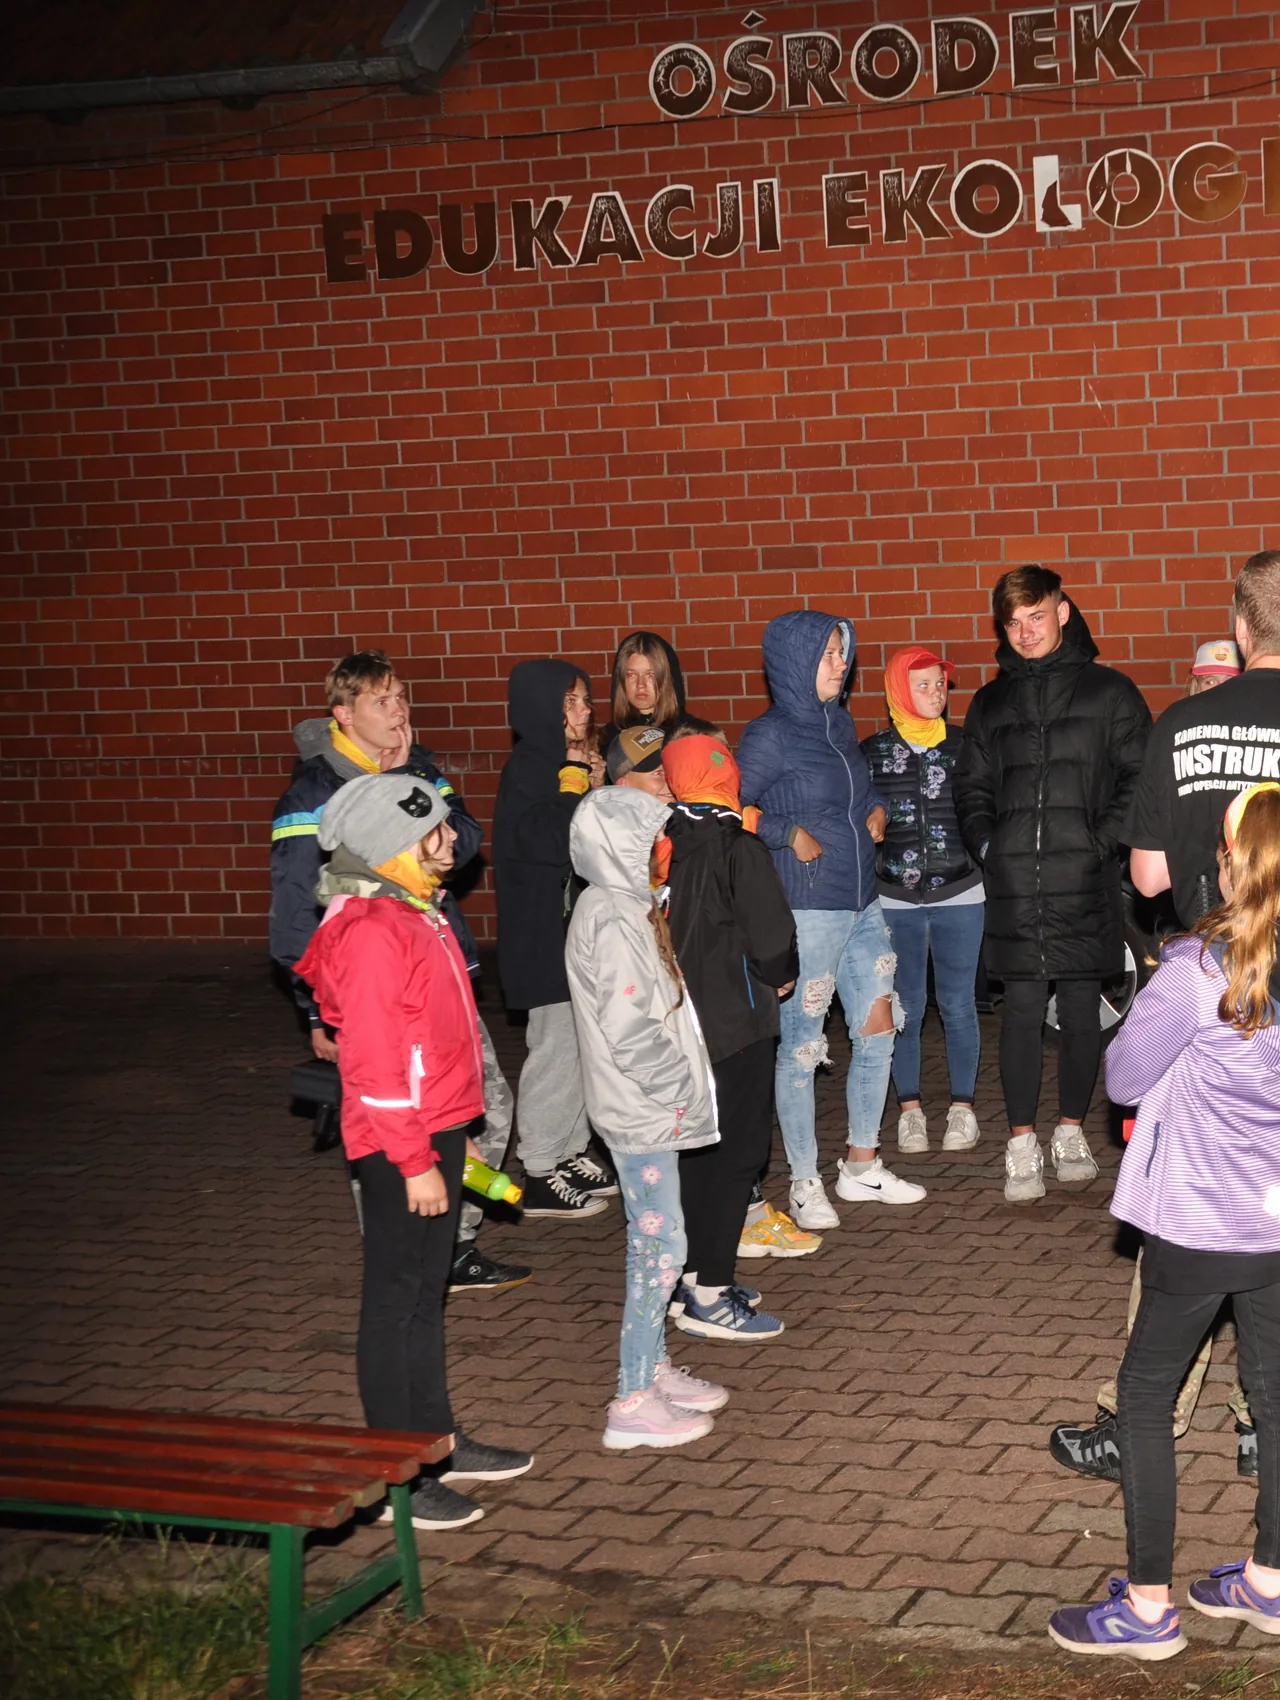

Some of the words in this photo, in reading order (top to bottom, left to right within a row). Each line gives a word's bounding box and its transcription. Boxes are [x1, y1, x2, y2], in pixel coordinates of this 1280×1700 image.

[649, 1, 1146, 118] OŚRODEK
[322, 177, 782, 285] EDUKACJI
[1174, 724, 1230, 747] KOMENDA
